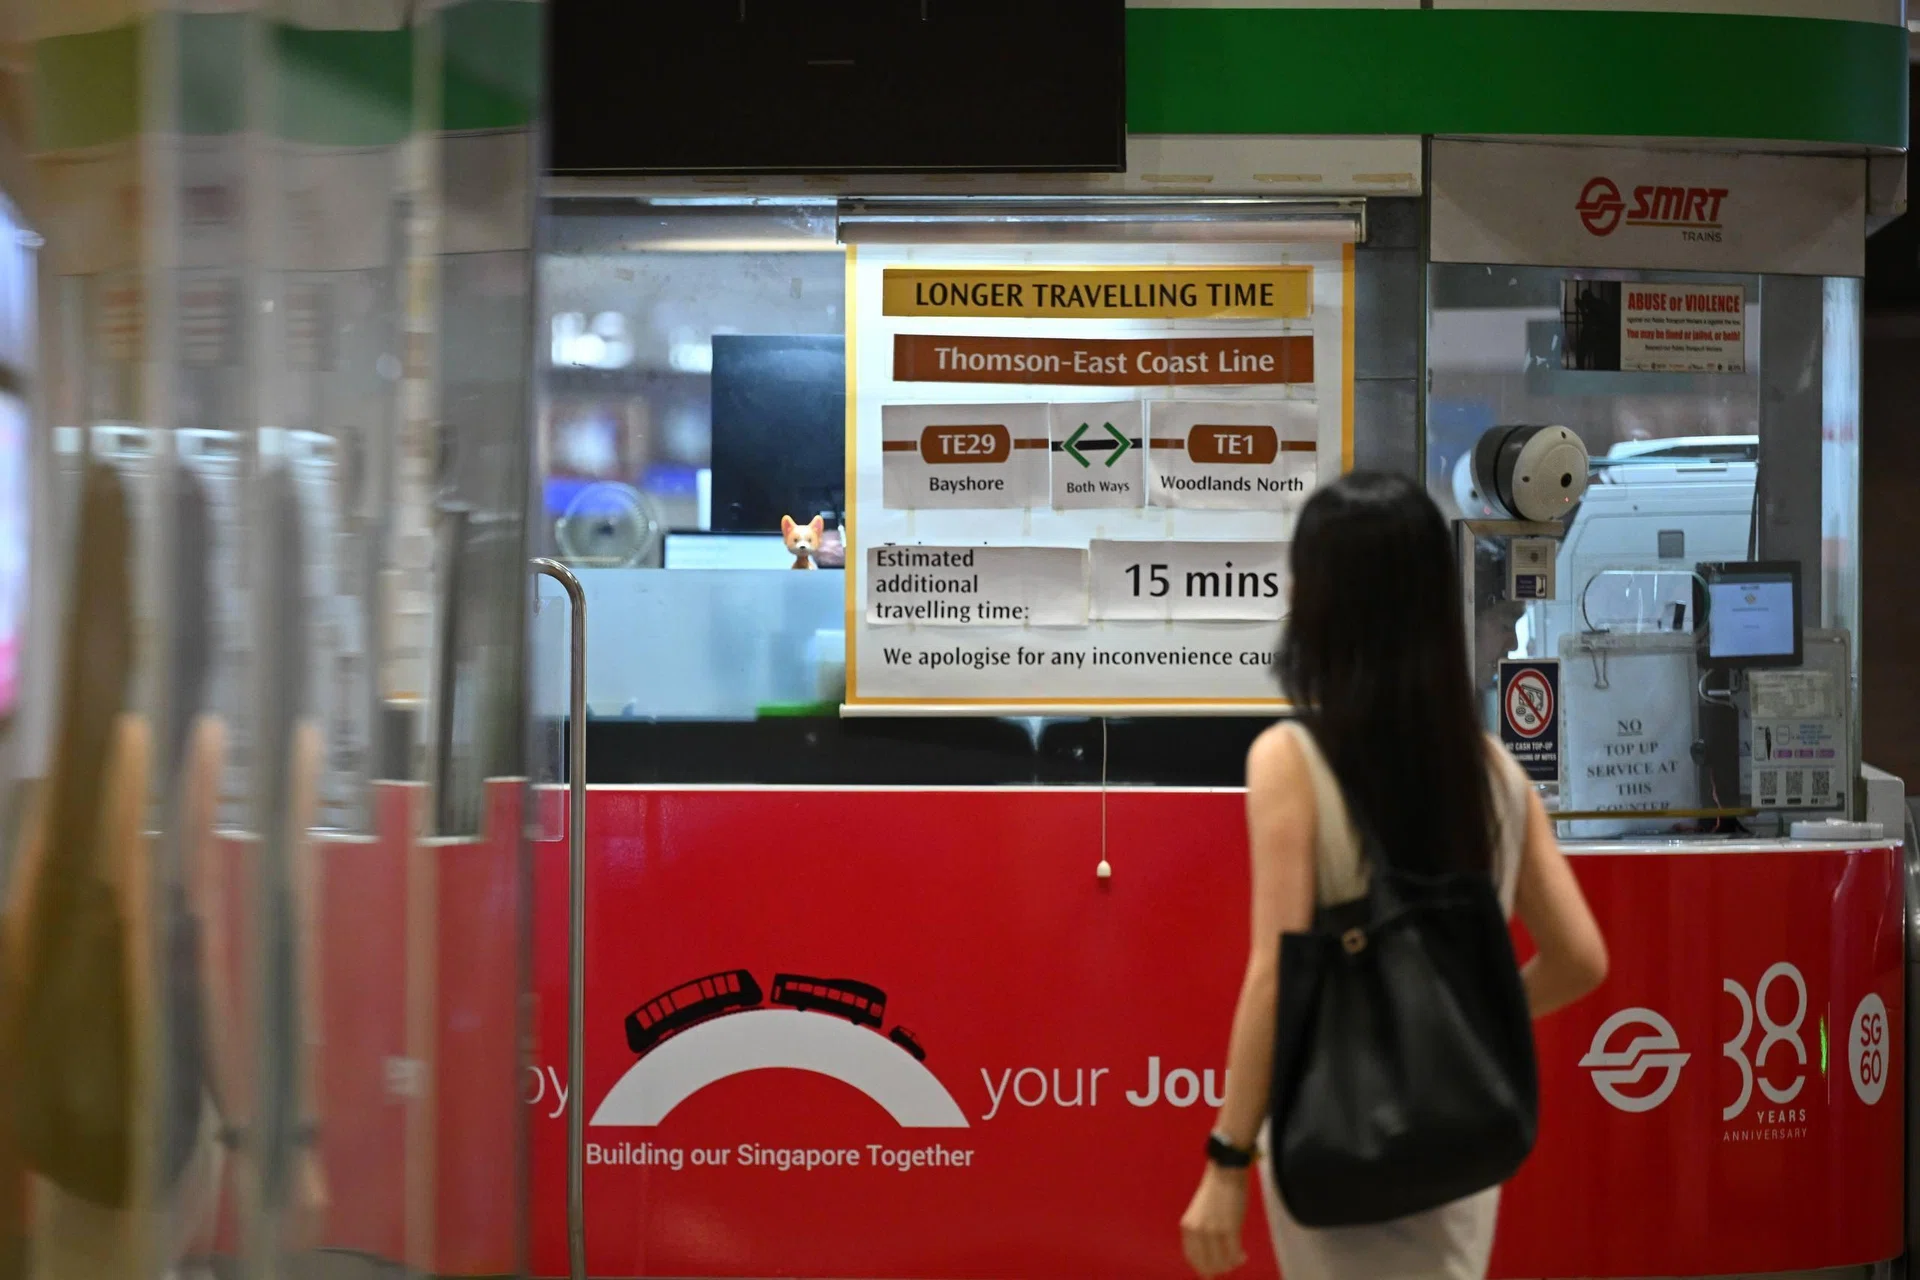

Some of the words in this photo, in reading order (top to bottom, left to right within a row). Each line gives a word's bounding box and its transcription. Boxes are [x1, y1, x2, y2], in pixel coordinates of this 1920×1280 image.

[1627, 186, 1729, 222] SMRT
[1681, 231, 1723, 243] TRAINS
[915, 282, 1023, 307] LONGER
[1032, 283, 1198, 308] TRAVELLING
[1206, 283, 1274, 307] TIME
[1628, 292, 1666, 311] ABUSE
[1669, 296, 1684, 312] or
[1685, 295, 1740, 313] VIOLENCE
[934, 347, 1128, 375] Thomson-East
[1136, 350, 1213, 375] Coast
[1219, 349, 1275, 373] Line
[937, 434, 997, 455] TE29
[1213, 433, 1254, 455] TE1
[929, 476, 1004, 494] Bayshore
[1066, 481, 1096, 494] Both
[1098, 481, 1130, 494] Ways
[1160, 475, 1251, 492] Woodlands
[1256, 477, 1304, 492] North
[876, 549, 975, 568] Estimated
[875, 575, 979, 594] additional
[1125, 563, 1170, 597] 15
[1186, 561, 1279, 597] mins
[875, 601, 971, 622] travelling
[977, 601, 1029, 621] time:
[884, 648, 912, 665] We
[918, 648, 1011, 670] apologise
[1017, 647, 1045, 665] for
[1051, 652, 1086, 670] any
[1092, 648, 1233, 666] inconvenience
[1617, 717, 1643, 736] NO
[1515, 742, 1531, 751] CASH
[1603, 742, 1635, 757] TOP
[1639, 741, 1659, 755] UP
[1586, 762, 1654, 778] SERVICE
[1658, 760, 1679, 774] AT
[1616, 782, 1653, 797] THIS
[1860, 1013, 1882, 1047] SG
[1723, 962, 1807, 1121] 38
[1860, 1050, 1882, 1086] 60
[980, 1064, 1109, 1121] your
[1757, 1108, 1807, 1124] YEARS
[1723, 1128, 1807, 1142] ANNIVERSARY
[586, 1143, 684, 1171] Building
[690, 1150, 731, 1168] our
[737, 1143, 860, 1172] Singapore
[867, 1144, 974, 1172] Together
